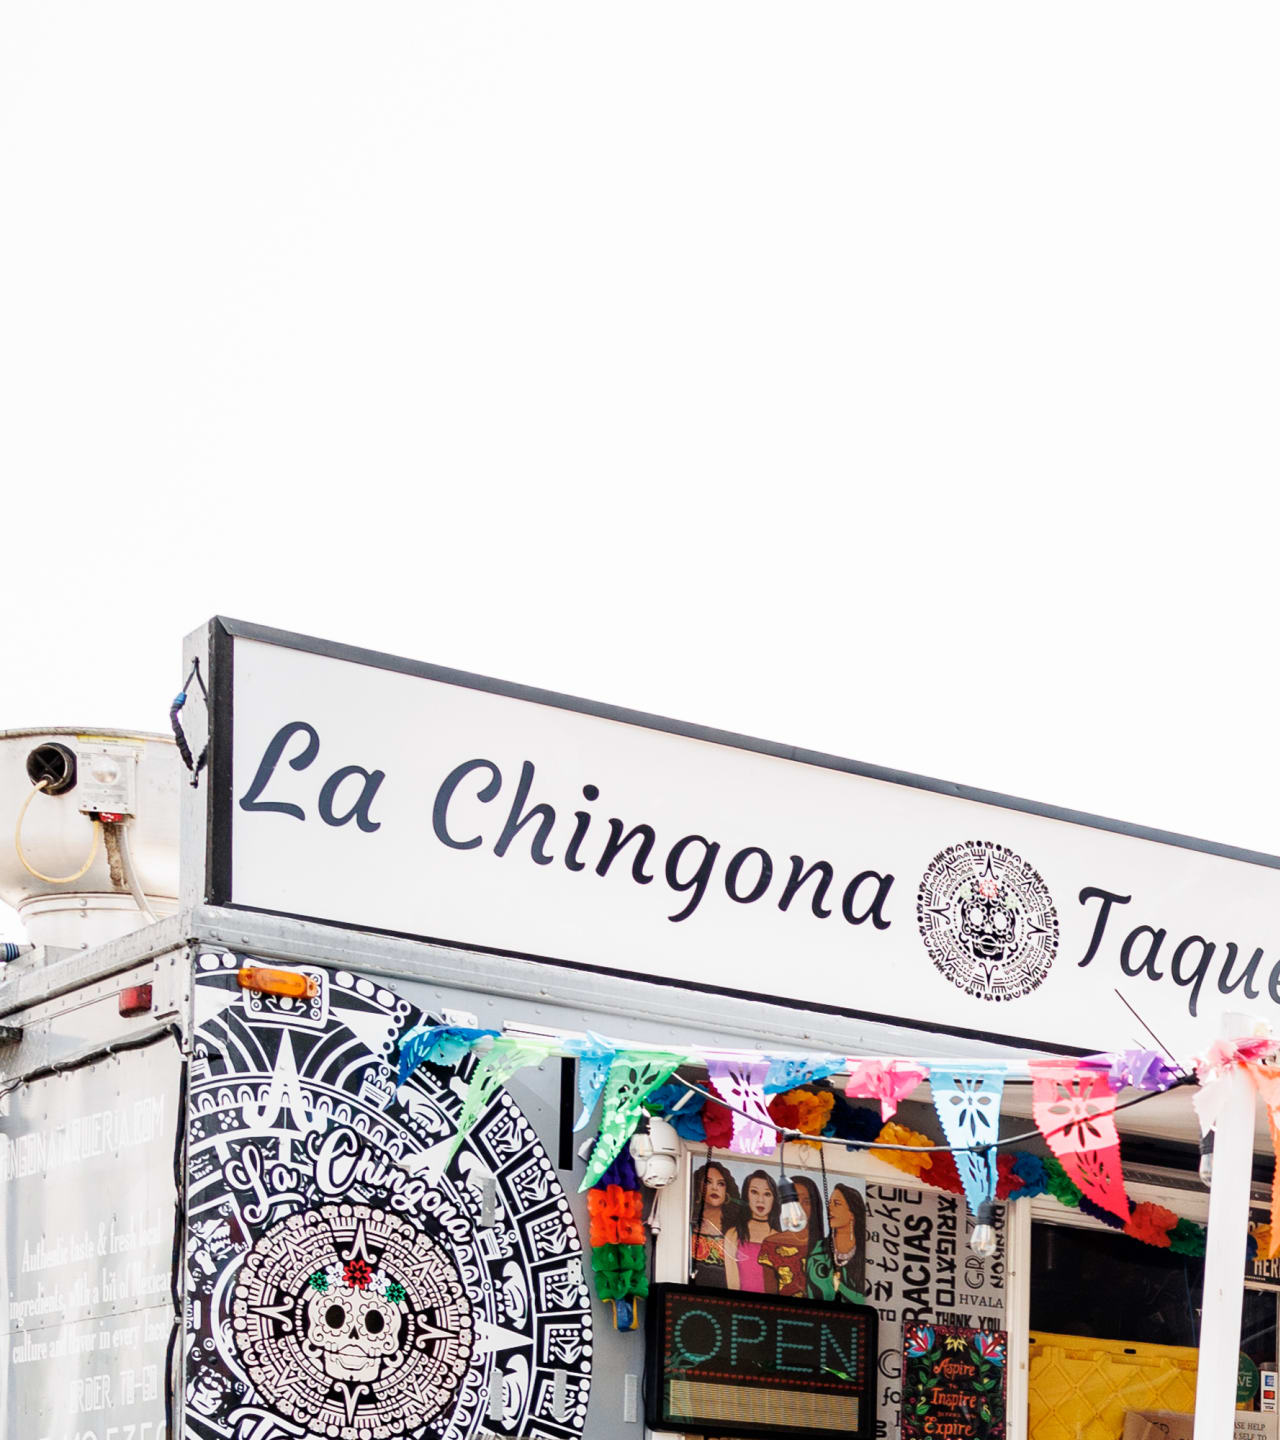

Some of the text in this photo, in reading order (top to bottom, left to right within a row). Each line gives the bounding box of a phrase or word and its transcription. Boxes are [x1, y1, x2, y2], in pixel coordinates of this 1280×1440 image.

[239, 721, 385, 833] La
[432, 758, 896, 931] Chingona
[227, 1129, 472, 1243] La Chingona
[902, 1215, 934, 1323] RACIAS
[959, 1293, 1004, 1309] HVALA
[935, 1311, 972, 1328] THANK
[674, 1310, 858, 1377] OPEN
[933, 1358, 976, 1380] Aspire
[931, 1386, 977, 1412] Inspire
[924, 1416, 976, 1437] Expire
[1247, 1423, 1266, 1431] HELP
